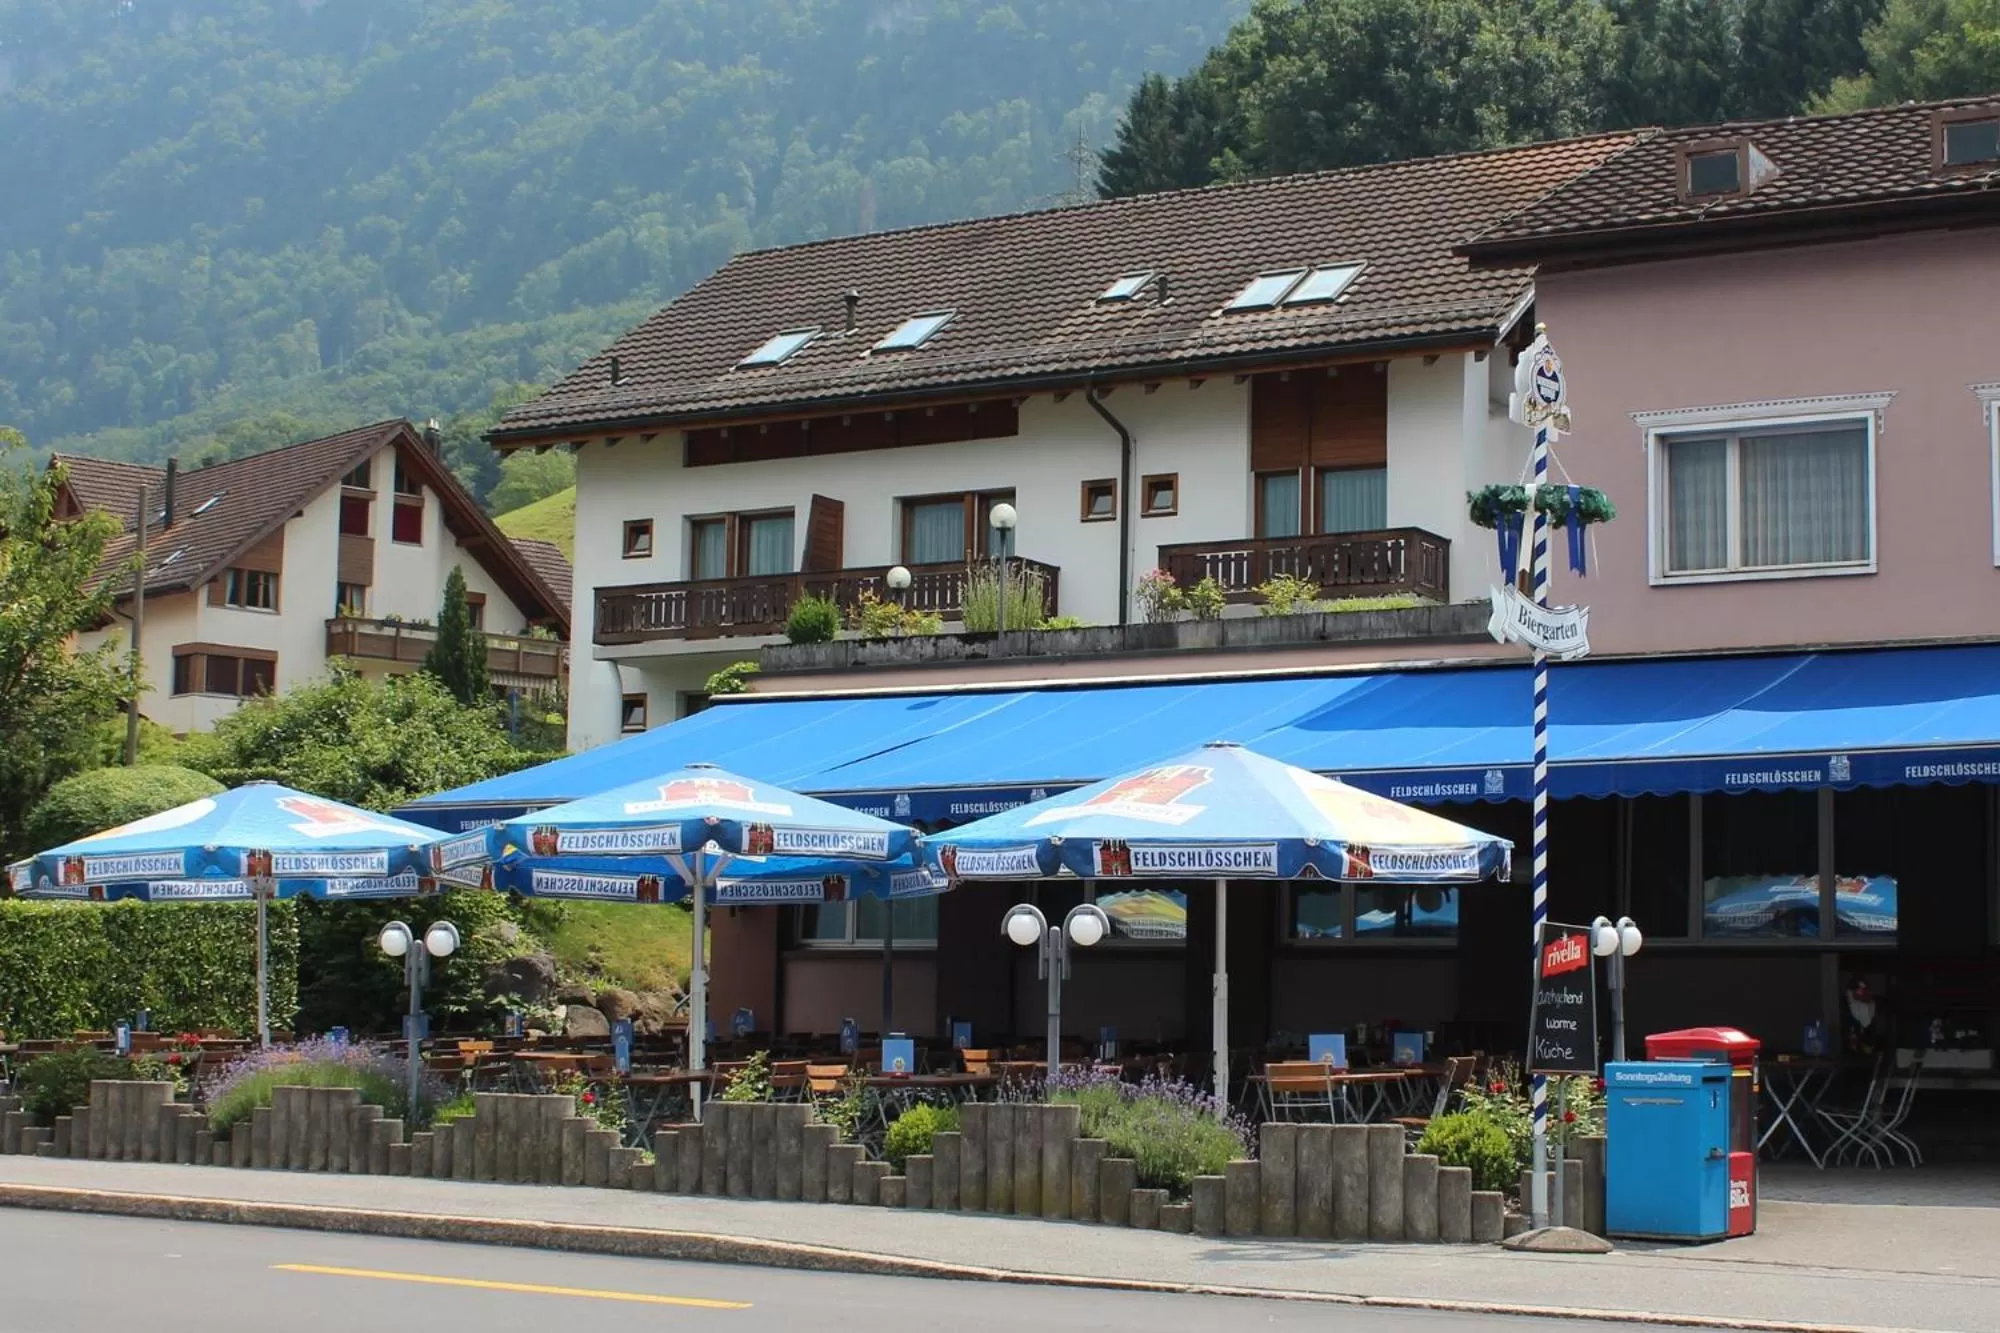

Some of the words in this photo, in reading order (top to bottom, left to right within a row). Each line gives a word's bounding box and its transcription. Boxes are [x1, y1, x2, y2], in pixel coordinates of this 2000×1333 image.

[1518, 604, 1578, 645] Biergarten
[1725, 769, 1821, 784] FELDSCHLÖSSCHEN
[1391, 783, 1478, 797] FELDSCHLÖSSCHEN
[560, 832, 677, 849] FELDSCHLÖSSCHEN
[776, 832, 885, 851] FELDSCHLÖSSCHEN
[86, 856, 181, 876] FELDSCHLÖSSCHEN
[275, 854, 385, 872] FELDSCHLÖSSCHEN
[957, 852, 1035, 870] FELDSCHLÖSSCHEN
[1134, 849, 1272, 867] FELDSCHLÖSSCHEN
[1547, 939, 1582, 968] rivella
[1535, 1035, 1576, 1060] Küche
